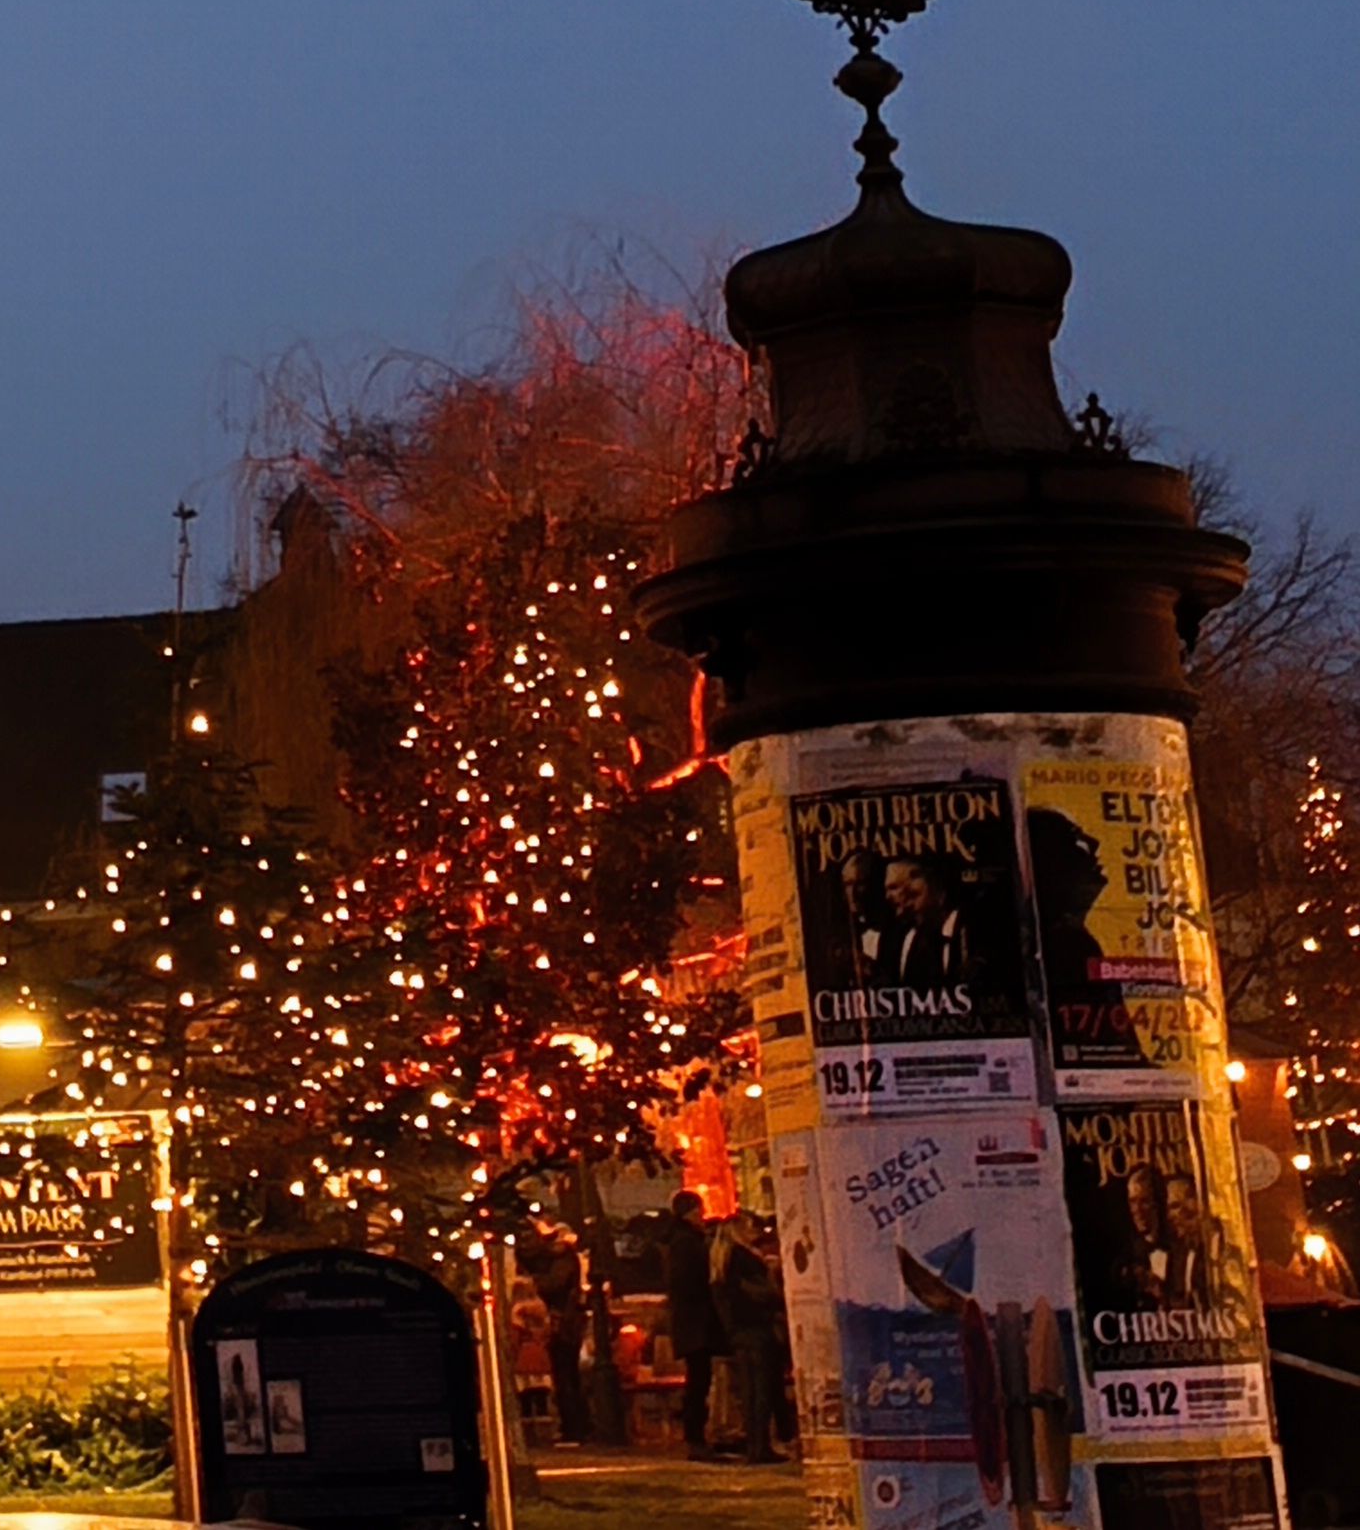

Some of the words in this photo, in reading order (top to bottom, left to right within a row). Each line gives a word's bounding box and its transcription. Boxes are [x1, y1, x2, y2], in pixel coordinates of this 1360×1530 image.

[796, 797, 884, 833] MONTI
[891, 790, 1001, 825] BETON
[817, 824, 937, 872] JOHANN
[1124, 863, 1171, 896] BIL
[1136, 901, 1175, 930] JO
[814, 983, 972, 1022] CHRISTMAS
[819, 1058, 886, 1096] 19.12
[1066, 1110, 1164, 1147] MONTI
[846, 1137, 941, 1204] Sagen
[867, 1167, 946, 1231] haft!
[1100, 1380, 1181, 1419] 19.12
